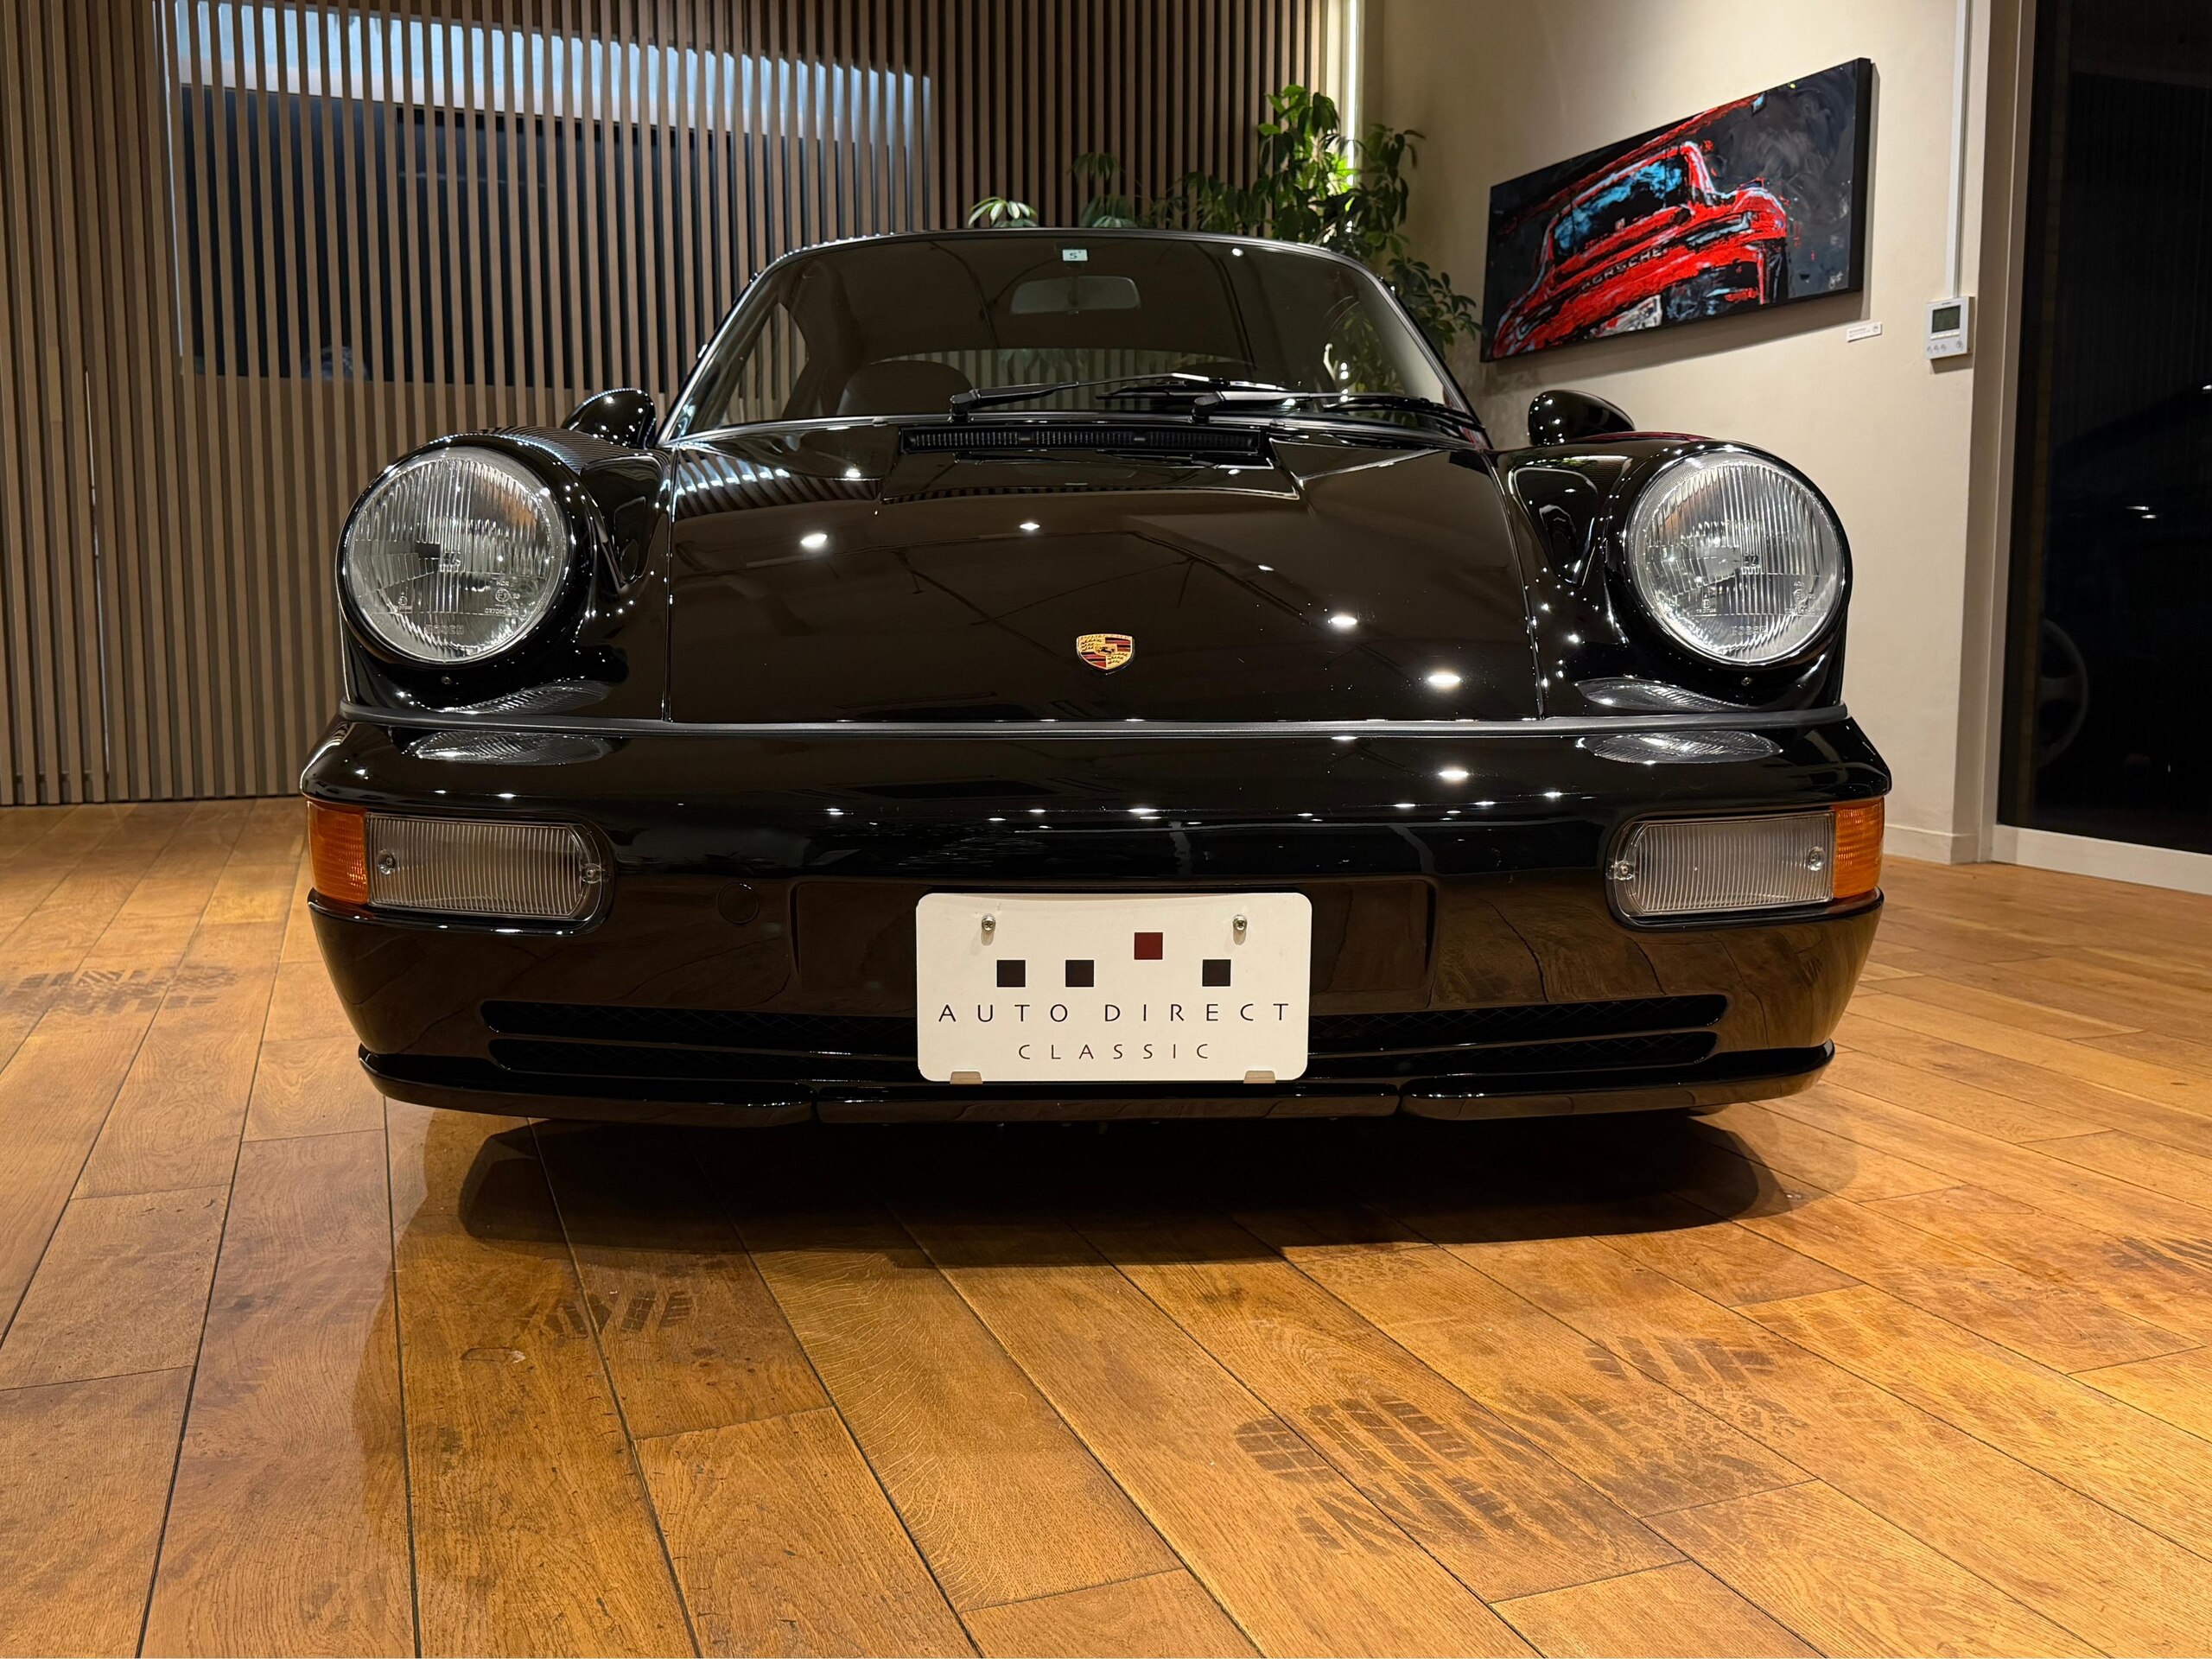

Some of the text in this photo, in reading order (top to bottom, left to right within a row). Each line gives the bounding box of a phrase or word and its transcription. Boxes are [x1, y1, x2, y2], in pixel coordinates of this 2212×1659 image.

[938, 1002, 1289, 1023] AUTO DIRECT
[1018, 1043, 1209, 1060] CLASSIC
